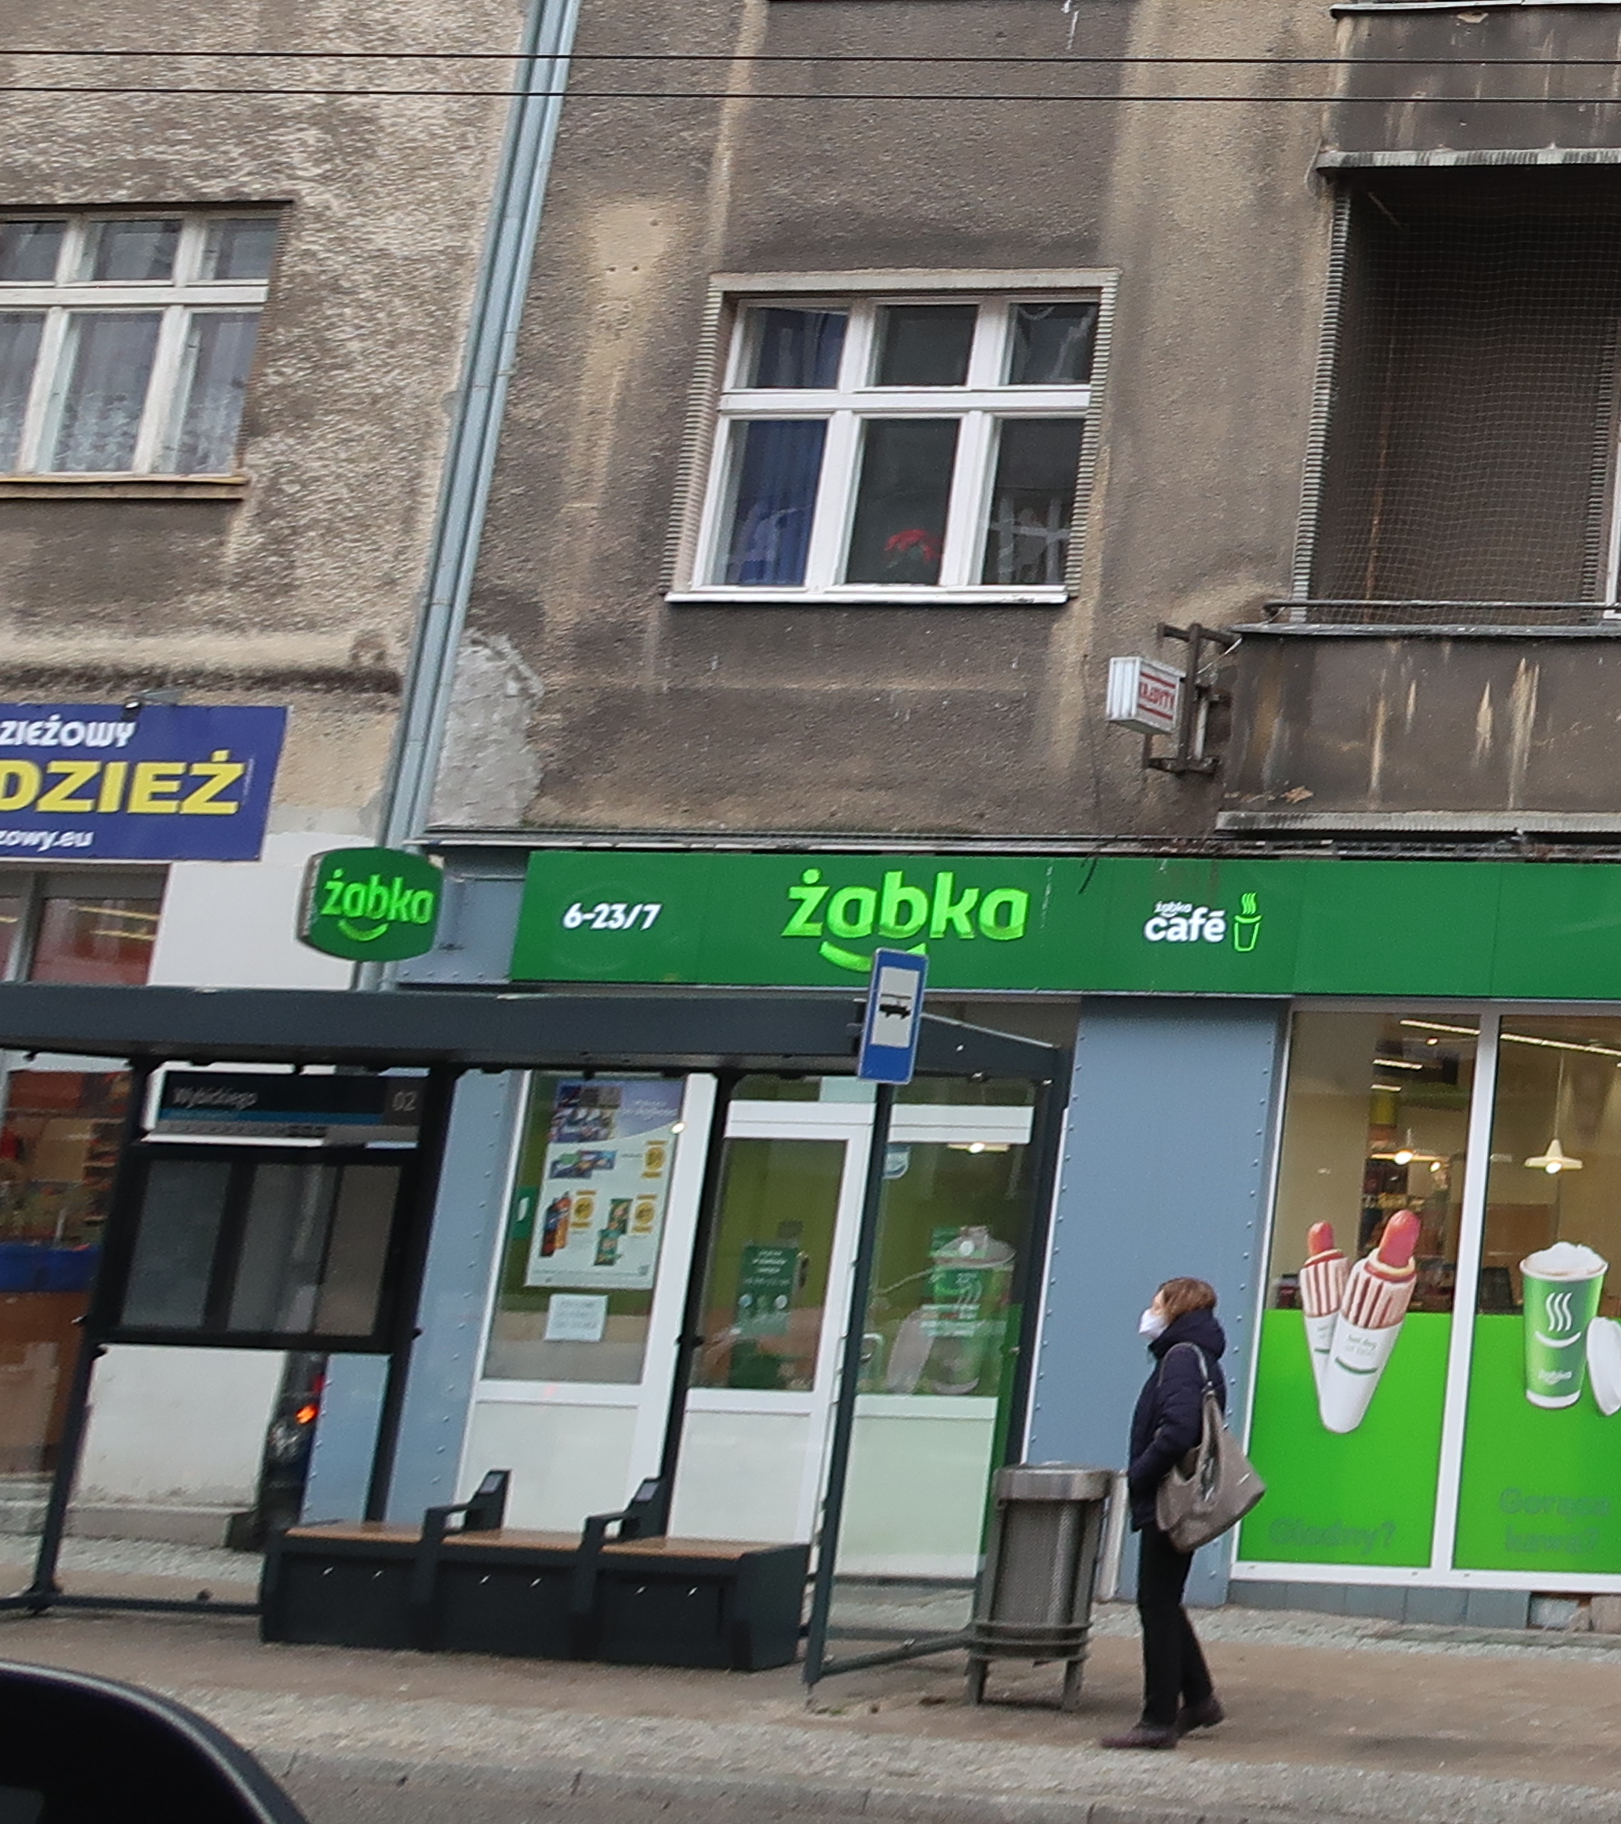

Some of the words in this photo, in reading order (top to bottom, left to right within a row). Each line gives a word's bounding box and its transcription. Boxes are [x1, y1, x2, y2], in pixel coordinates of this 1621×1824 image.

[320, 868, 435, 925] żabka
[563, 902, 662, 931] 6-23/7
[781, 869, 1029, 940] żabka
[1143, 909, 1227, 943] café
